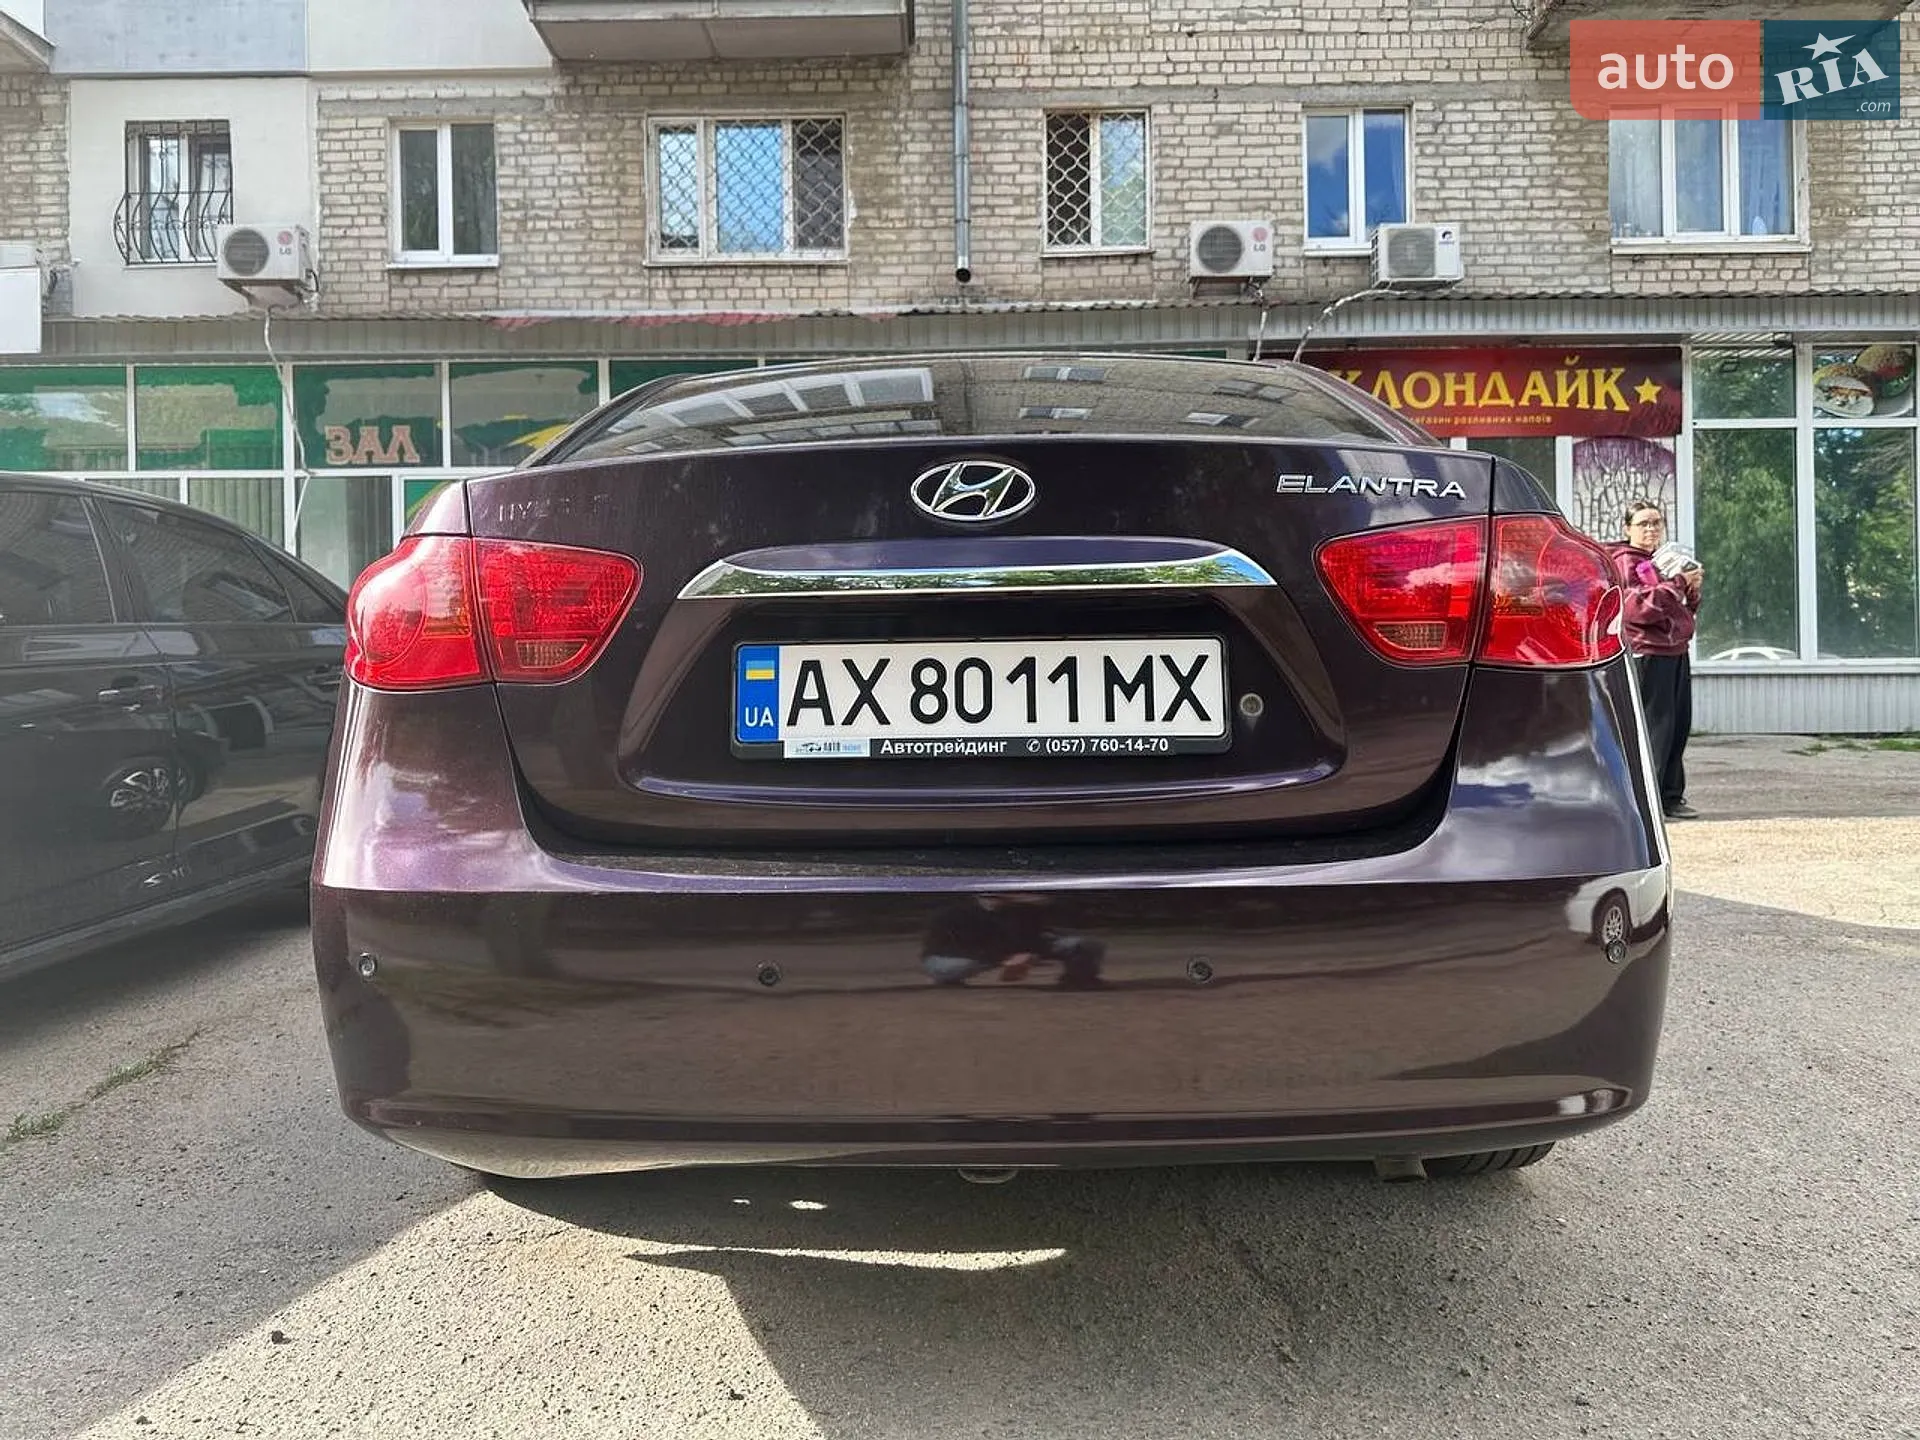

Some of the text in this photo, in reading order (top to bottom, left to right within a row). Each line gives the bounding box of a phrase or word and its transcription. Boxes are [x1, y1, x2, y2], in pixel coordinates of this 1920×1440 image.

[1253, 243, 1266, 251] LG
[324, 424, 420, 465] ЗАЛ
[1276, 474, 1467, 499] ELANTRA
[786, 654, 1212, 726] AX 8011 MX
[745, 706, 774, 727] UA
[880, 738, 1008, 756] Автотрейдинг
[1045, 738, 1086, 753] (057)
[1090, 737, 1169, 752] 760-14-70
